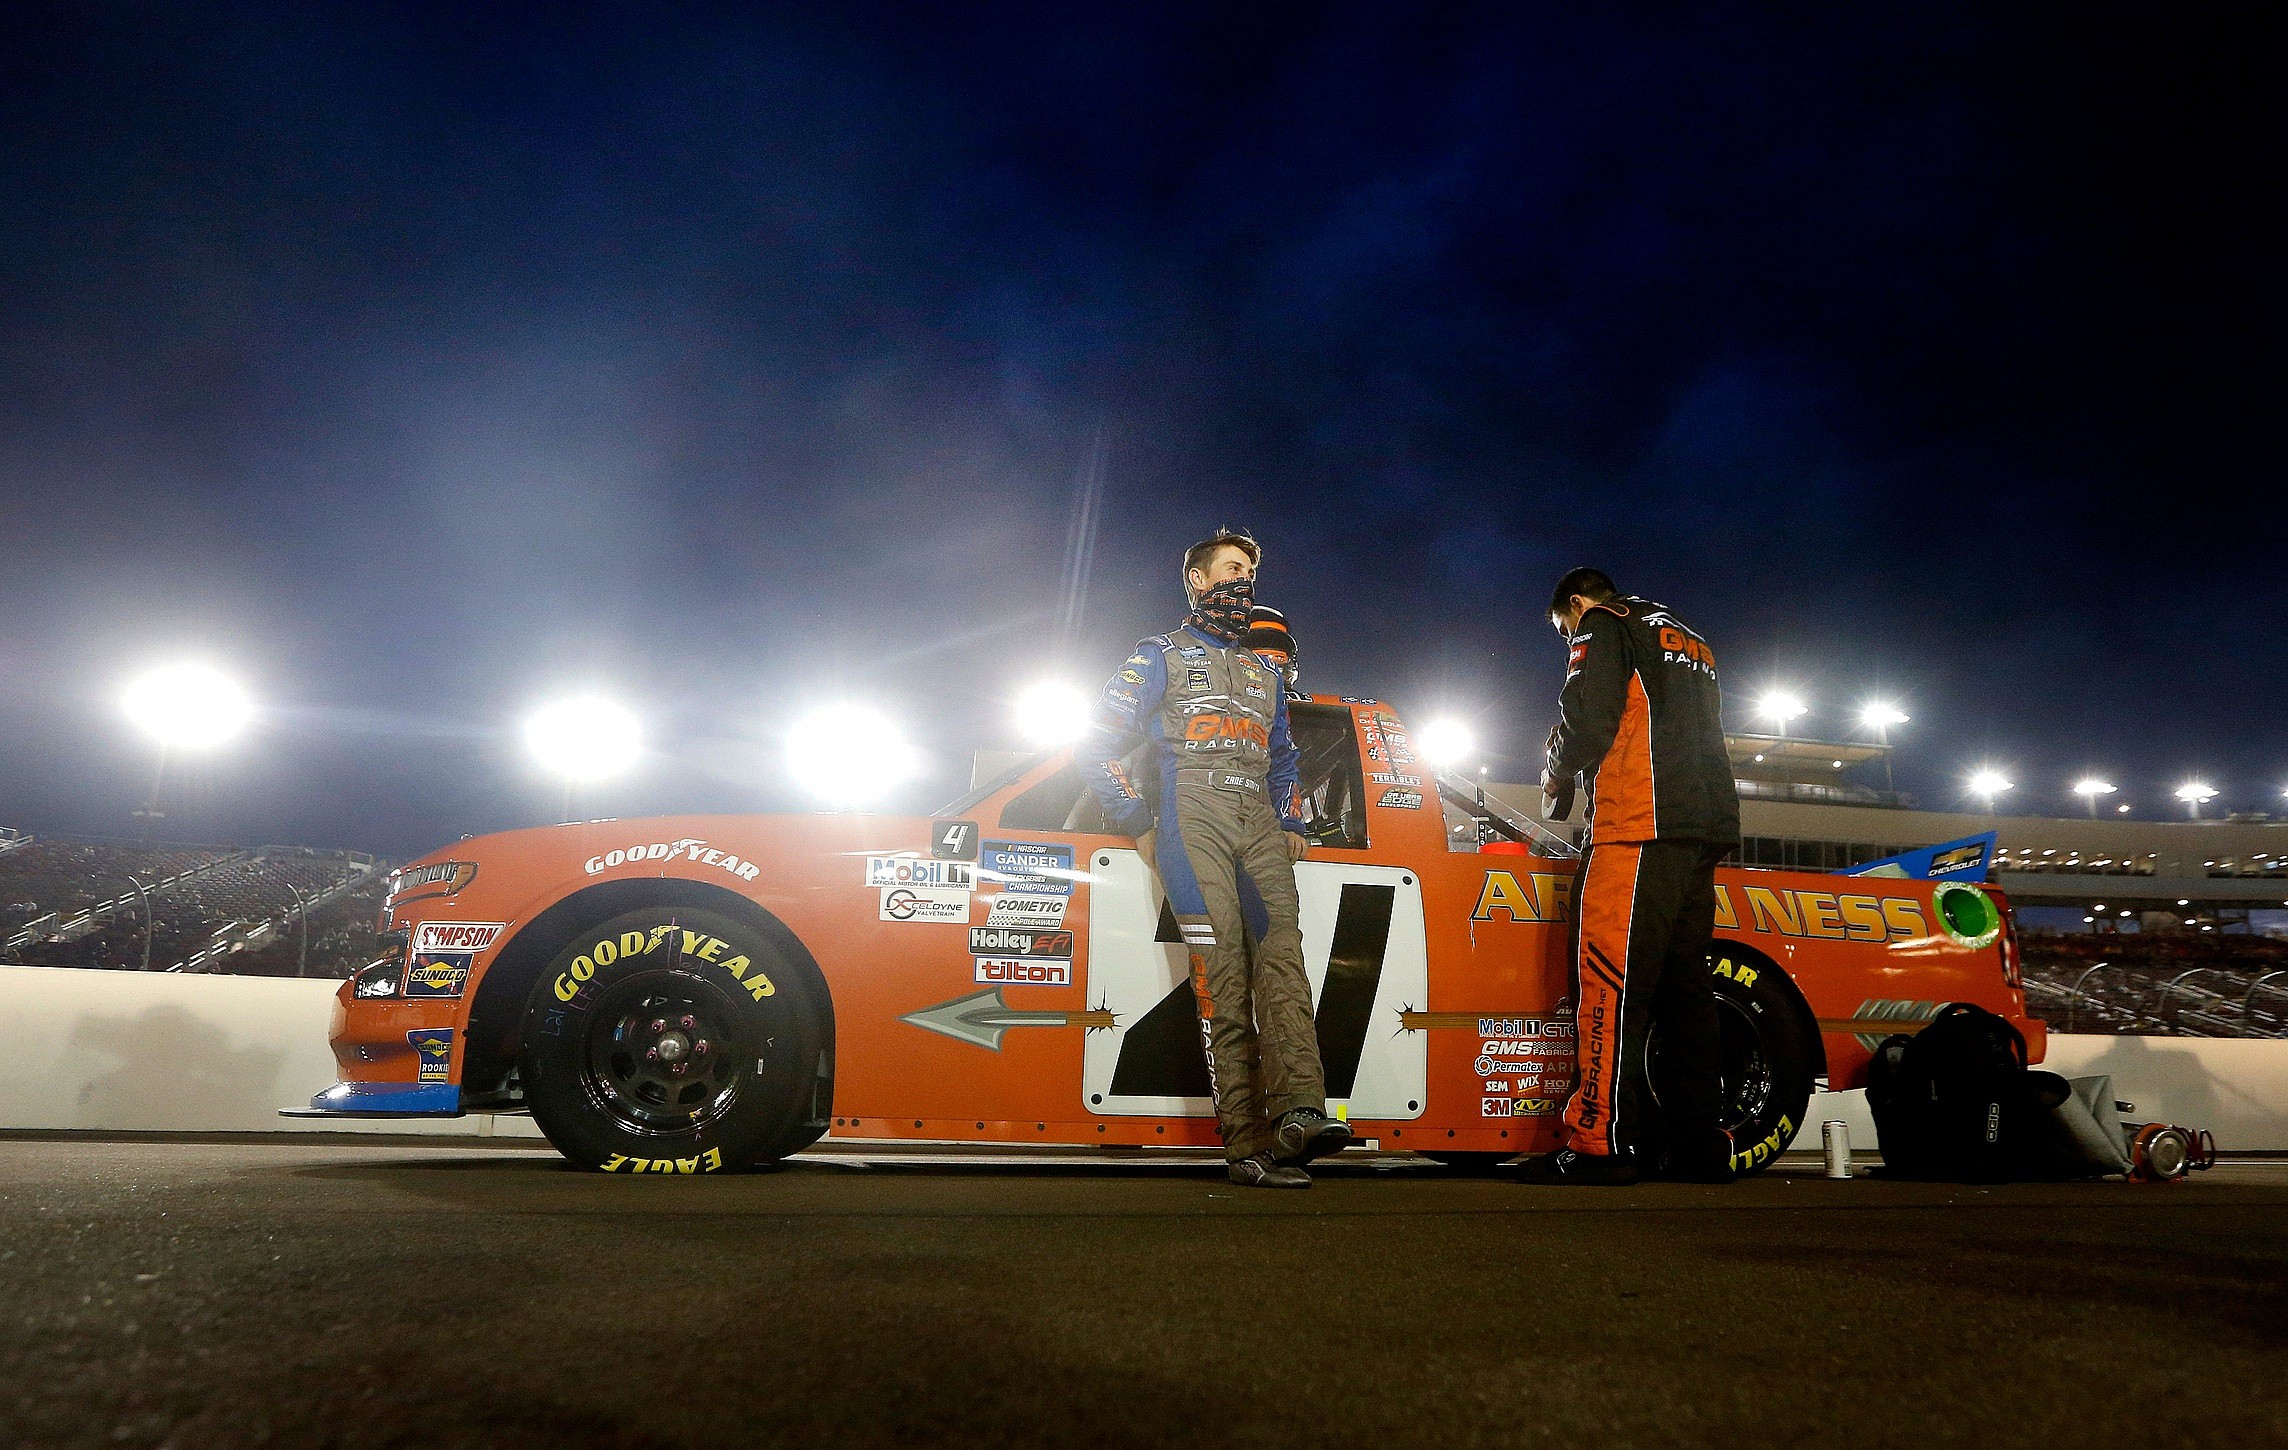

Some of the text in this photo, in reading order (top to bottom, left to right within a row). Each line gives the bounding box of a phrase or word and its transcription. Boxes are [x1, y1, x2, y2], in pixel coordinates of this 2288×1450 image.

[1108, 689, 1139, 706] allegiant
[1184, 714, 1268, 748] GMS
[1382, 796, 1421, 805] EDGE
[942, 825, 969, 854] 4
[1016, 844, 1048, 854] NASCAR
[995, 853, 1058, 868] GANDER
[1927, 858, 1982, 877] CHEVROLET
[873, 860, 941, 882] Mobil
[1009, 882, 1069, 893] CHAMPIONSHIP
[996, 899, 1063, 913] COMETIC
[1743, 885, 1930, 945] NESS
[422, 926, 498, 947] SIMPSON
[971, 929, 1033, 954] Holley
[411, 968, 466, 982] SUNOCO
[982, 960, 1065, 982] tilton
[1479, 1018, 1523, 1036] Mobil
[1481, 1040, 1534, 1055] GMS
[1493, 1060, 1544, 1073] Permatex
[1485, 1080, 1509, 1093] SEM
[1517, 1074, 1540, 1090] WIX
[1484, 1099, 1510, 1116] 3M
[599, 1146, 722, 1174] EAGLE
